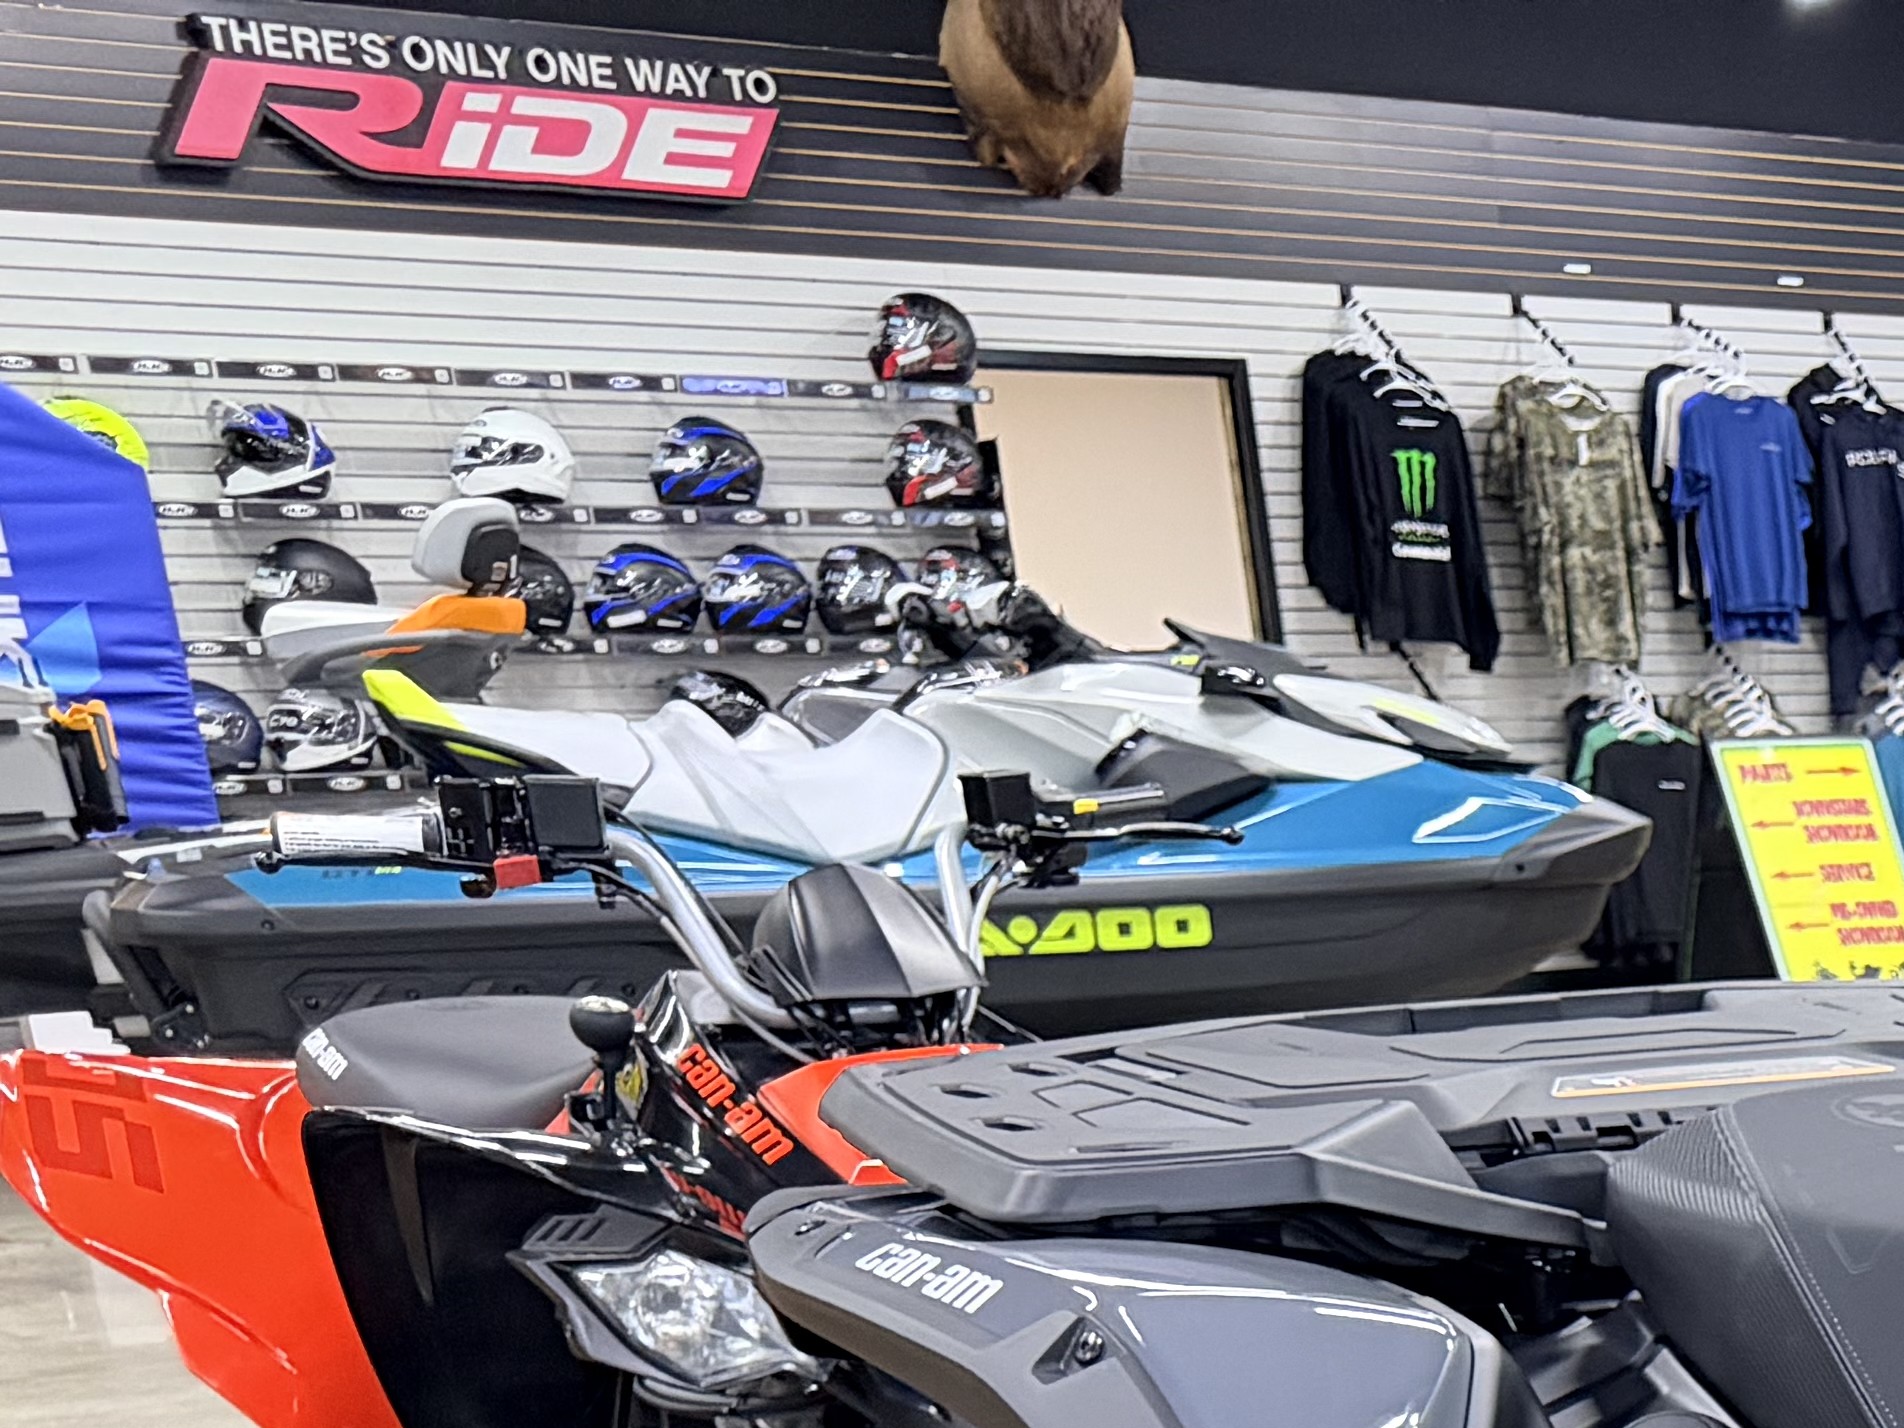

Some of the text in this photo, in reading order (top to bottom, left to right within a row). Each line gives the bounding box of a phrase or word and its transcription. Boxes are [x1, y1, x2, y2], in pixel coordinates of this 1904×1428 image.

[202, 15, 777, 104] THERE'S ONLY ONE WAY TO
[301, 1027, 349, 1081] can-am
[678, 1043, 794, 1166] can-am
[855, 1242, 1004, 1315] can-am
